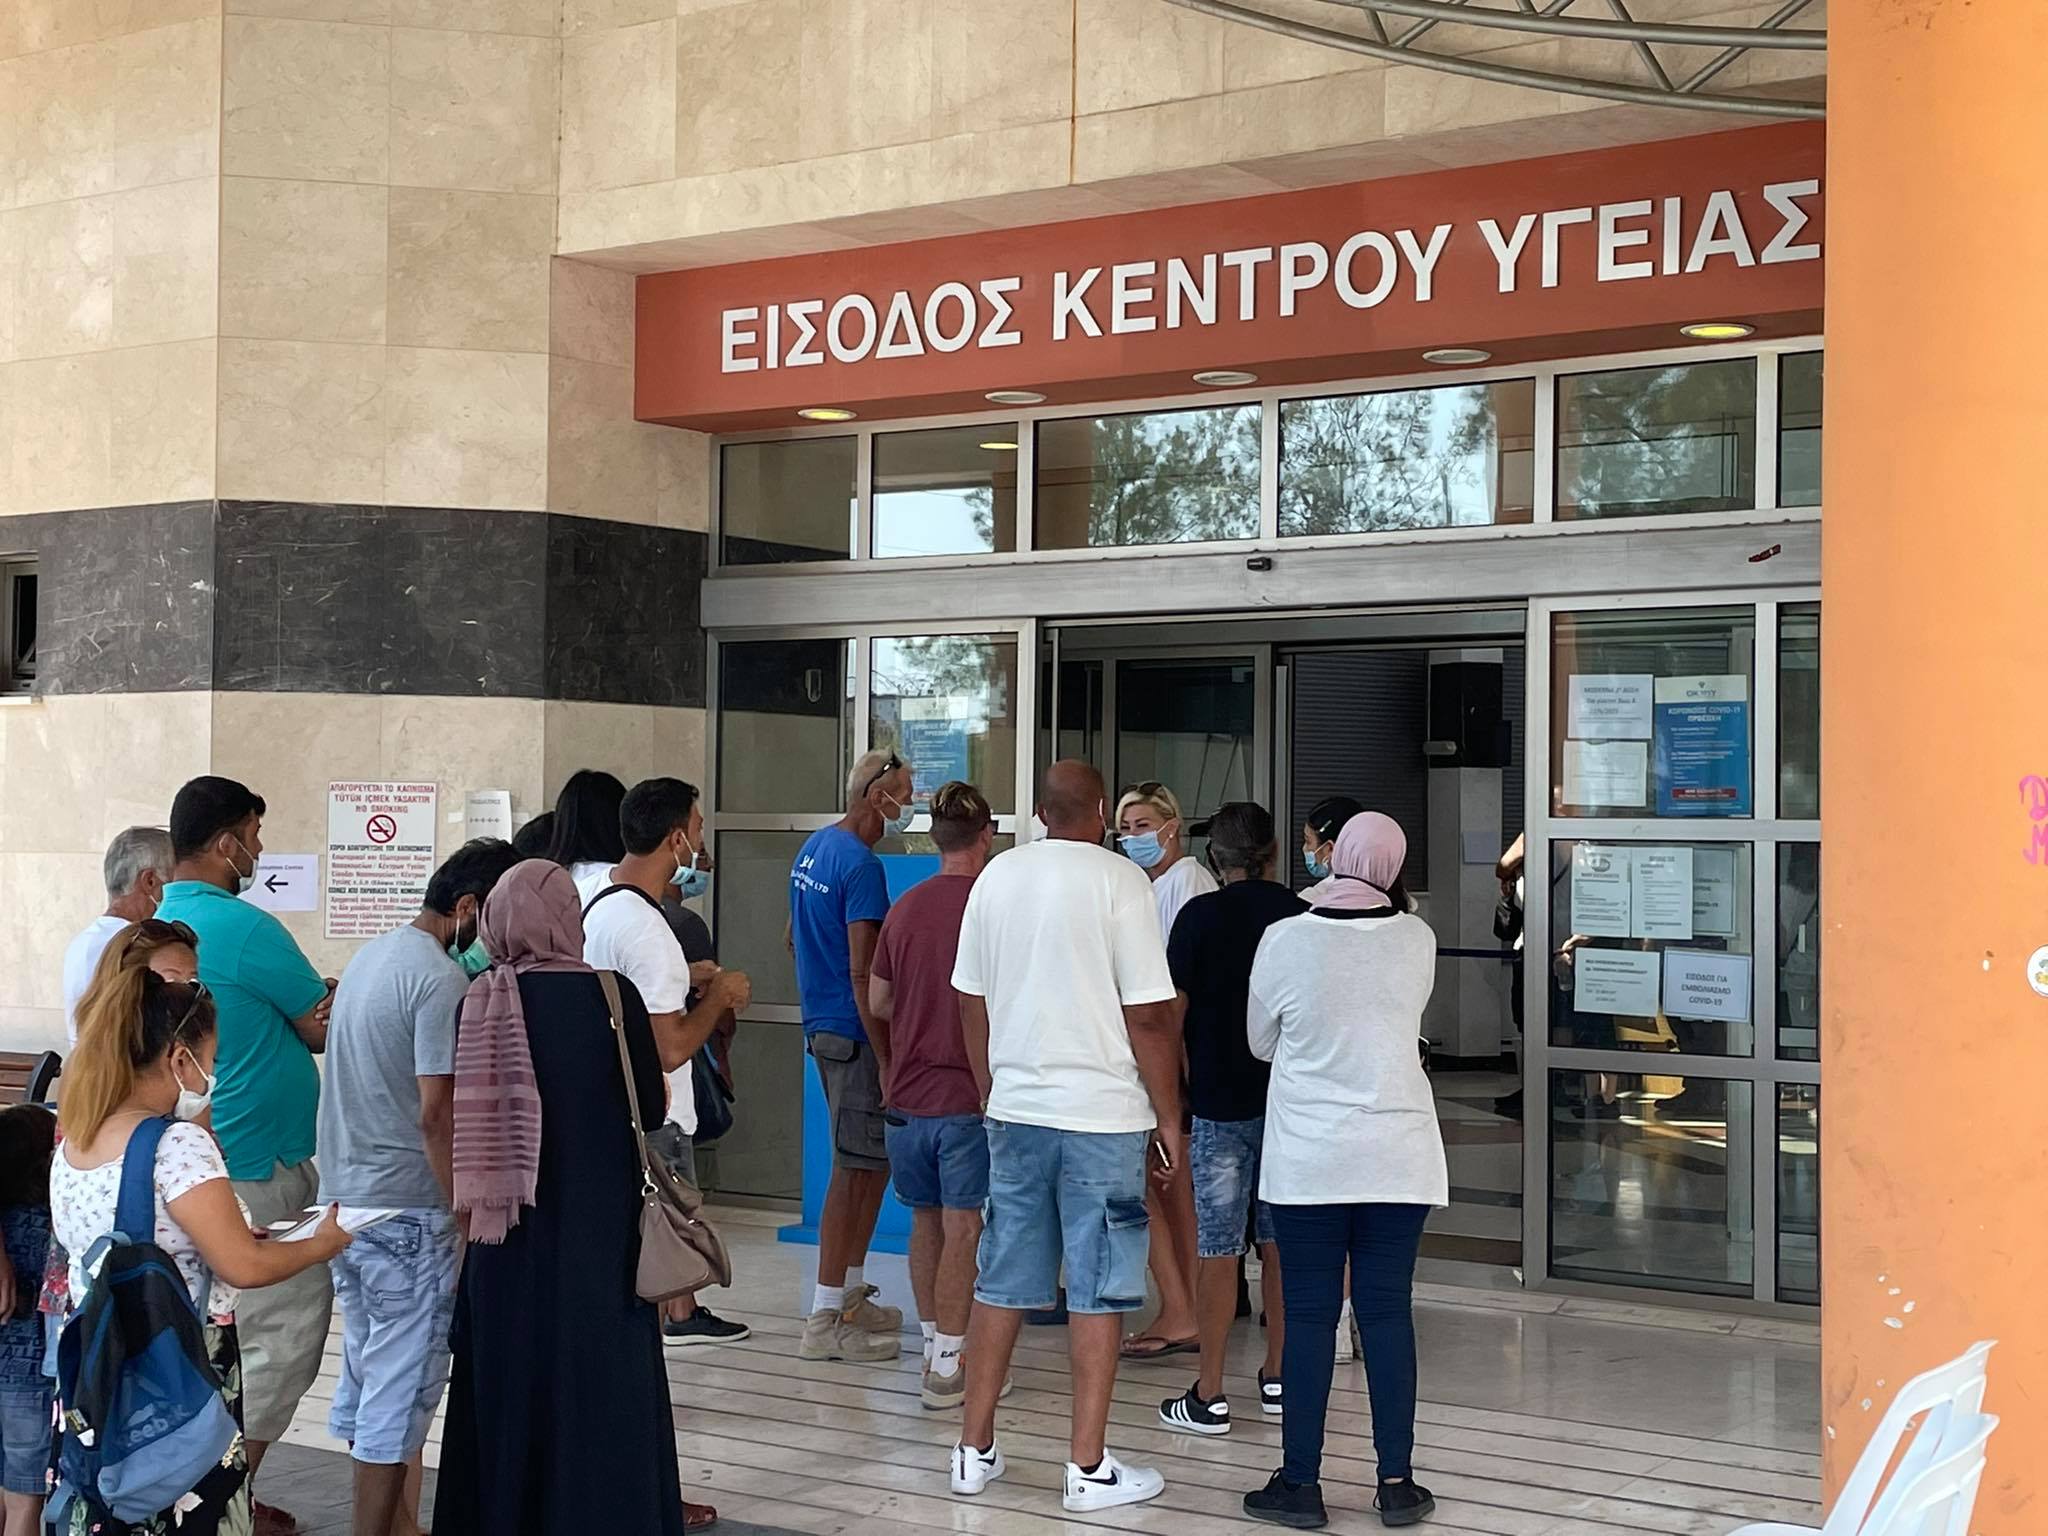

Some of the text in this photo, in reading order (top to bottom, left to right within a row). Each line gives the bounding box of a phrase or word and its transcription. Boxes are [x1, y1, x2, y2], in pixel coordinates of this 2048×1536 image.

[722, 179, 1822, 373] ΕΙΣΟΔΟΣ ΚΕΝΤΡΟΥ ΥΓΕΙΑΣ
[371, 805, 408, 813] SMOKING
[1688, 995, 1722, 1006] COVID-19
